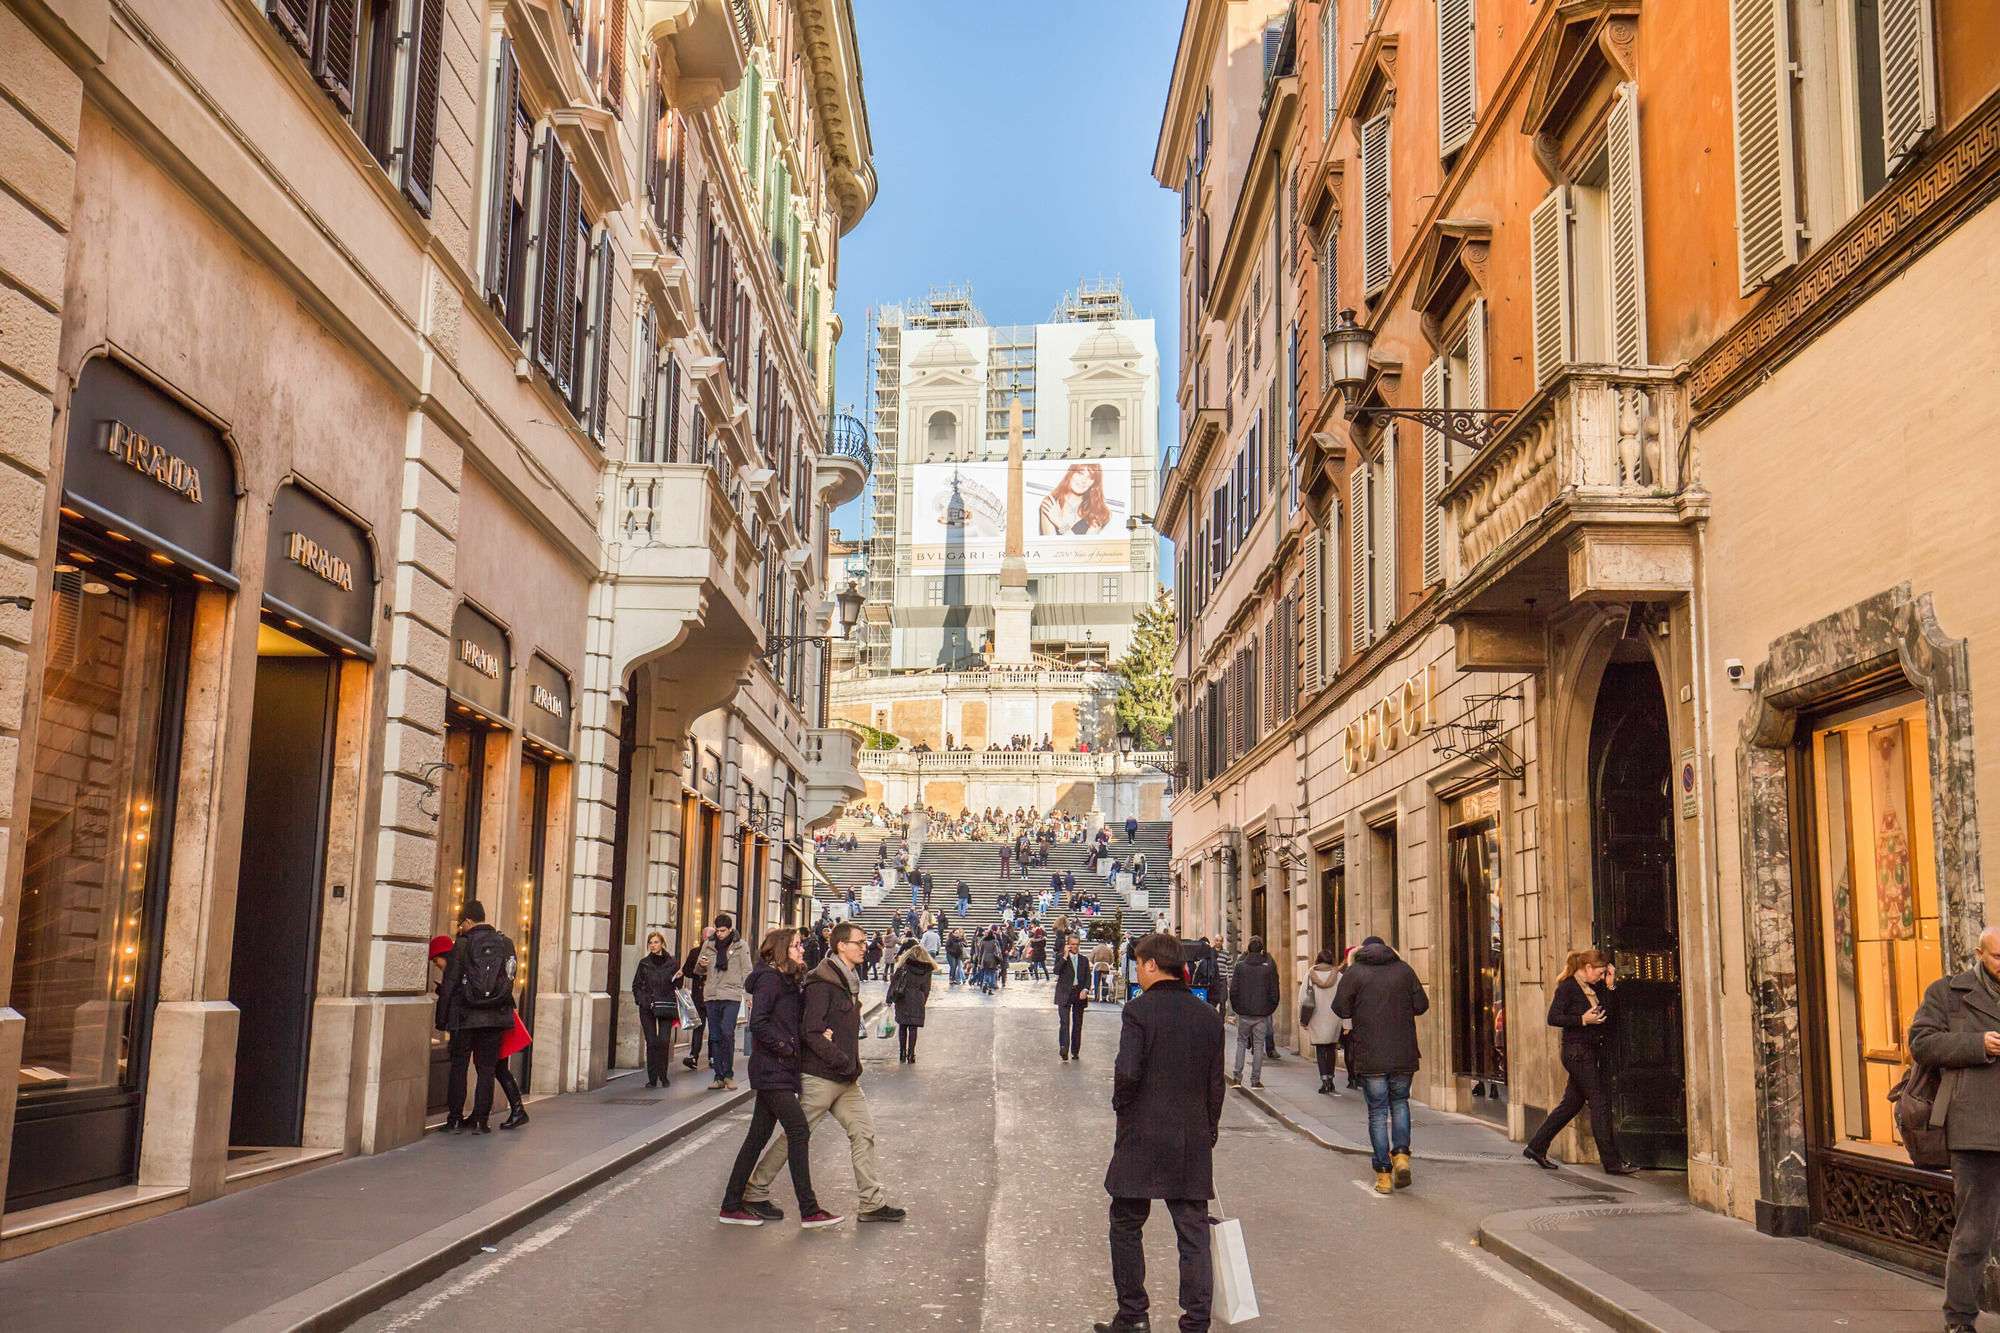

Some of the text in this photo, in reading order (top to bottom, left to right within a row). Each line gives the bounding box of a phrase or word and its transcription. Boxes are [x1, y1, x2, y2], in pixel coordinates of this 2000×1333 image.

[109, 420, 203, 504] PRADA
[290, 531, 353, 592] PRADA
[916, 551, 985, 560] BVLGARI
[998, 550, 1041, 559] RMA
[461, 640, 498, 679] PRADA
[533, 685, 562, 719] PRADA
[1343, 664, 1434, 774] GUCCI
